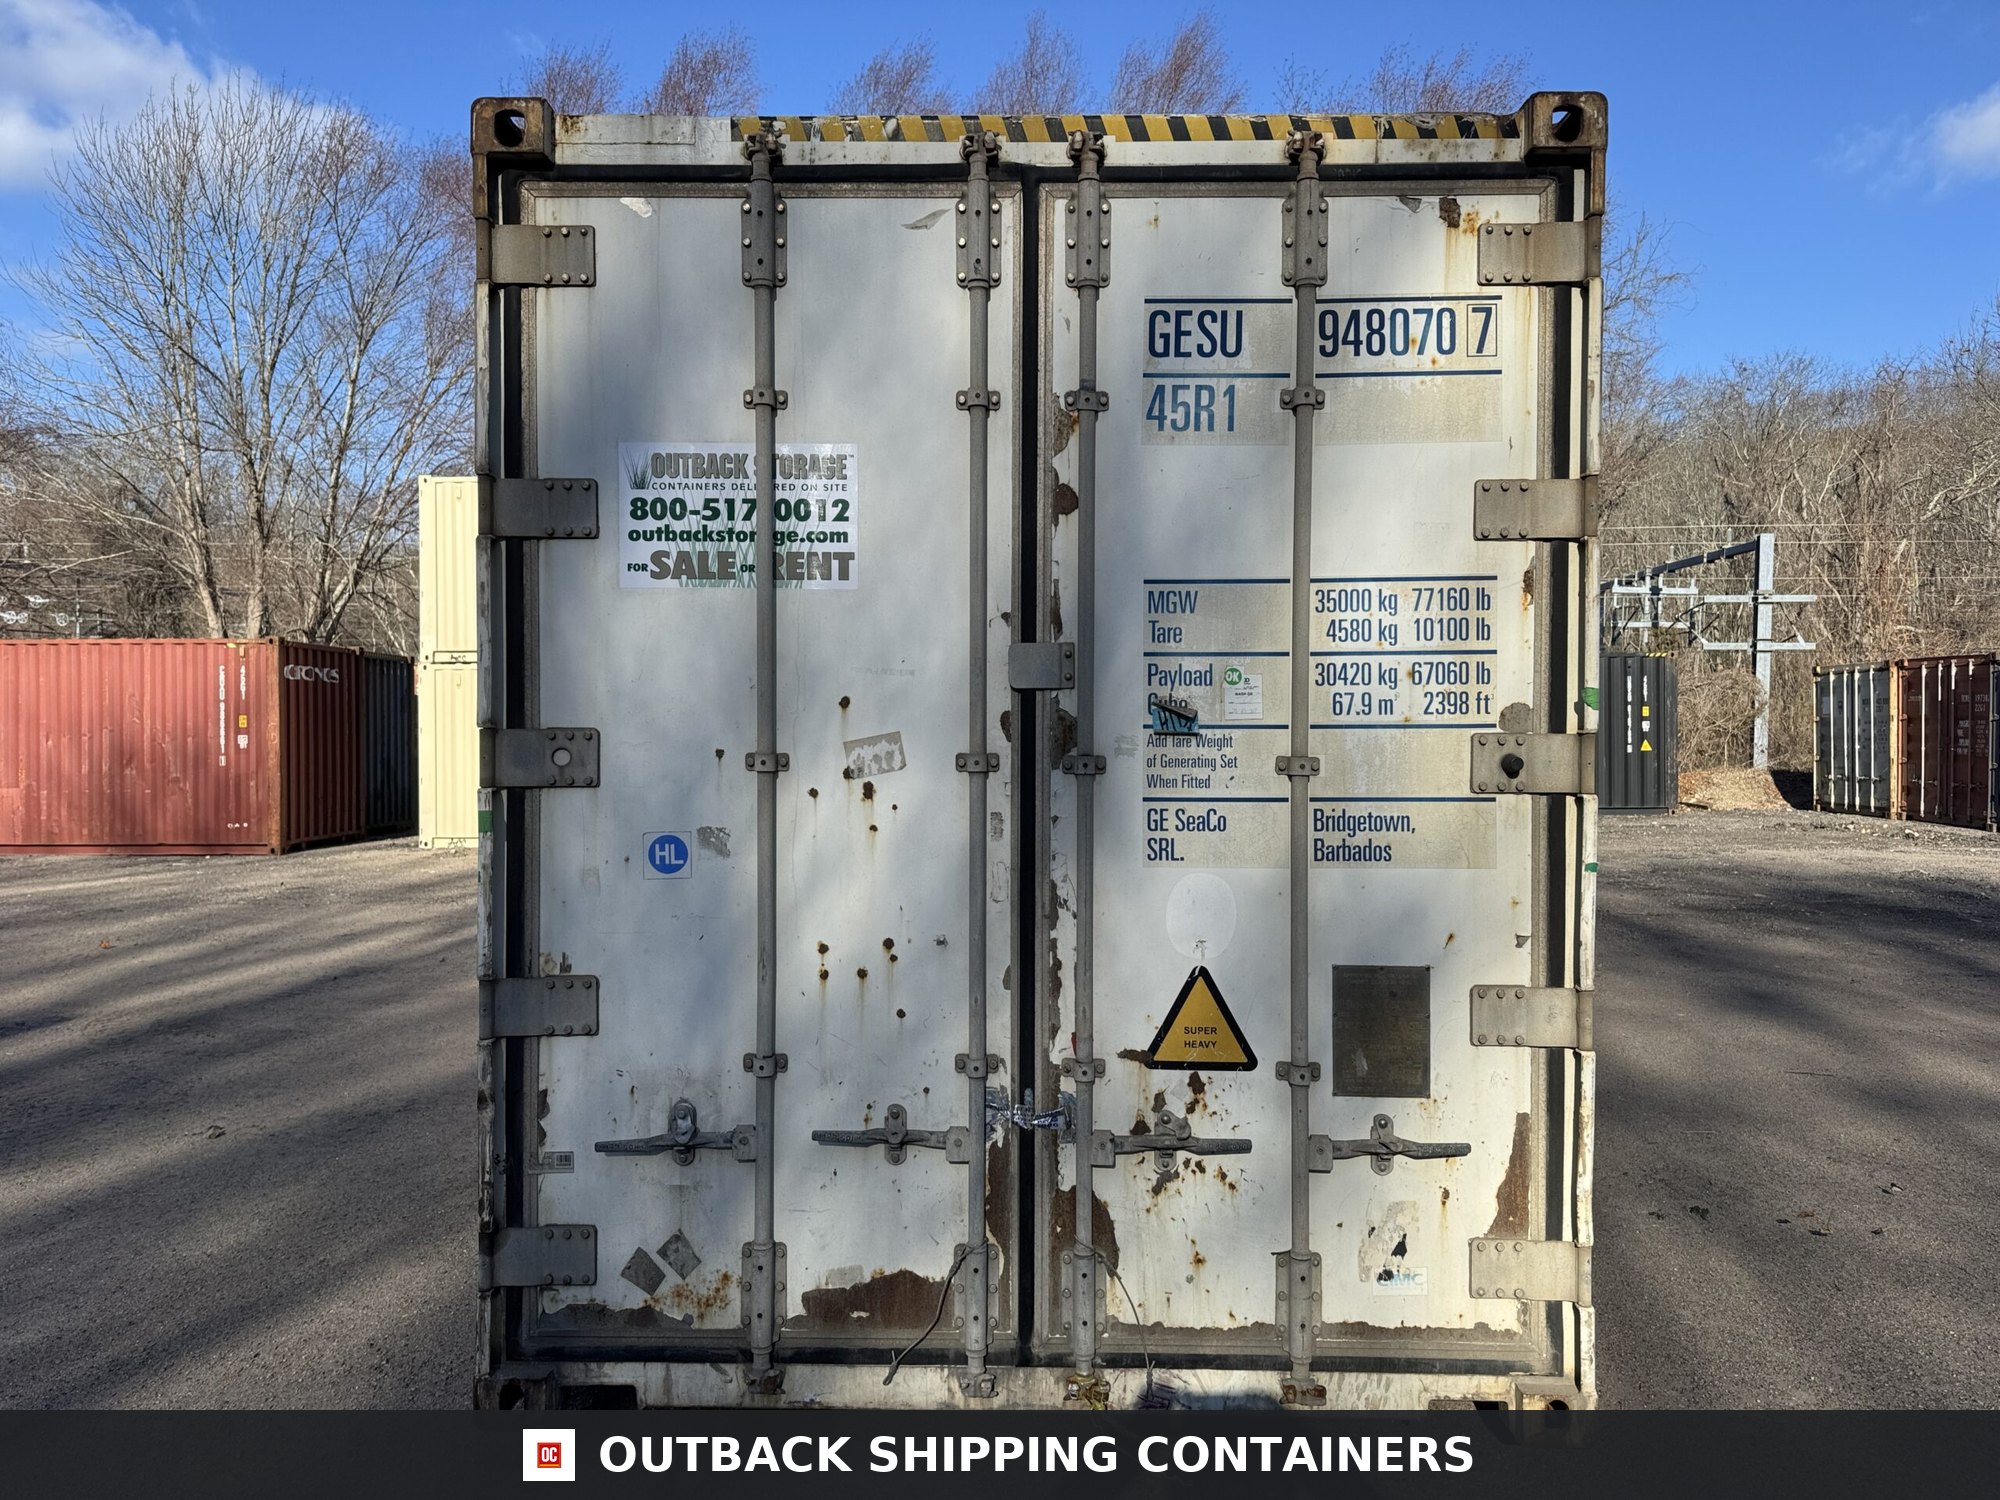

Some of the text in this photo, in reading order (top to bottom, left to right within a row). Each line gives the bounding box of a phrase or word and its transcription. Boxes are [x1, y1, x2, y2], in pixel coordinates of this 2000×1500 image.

[1149, 306, 1493, 358] GESU 948070 7
[1146, 384, 1236, 432] 45R1
[651, 452, 848, 480] OUTBACK TORAGE
[651, 482, 848, 492] CONTAINERS DELIRED ON SITE
[629, 497, 850, 522] 800-5170012
[627, 525, 849, 547] outbackstorge.com
[627, 550, 855, 581] FOR SALE OR RENT
[1148, 587, 1491, 616] MGW 35000 kg 77160 lb
[1148, 617, 1491, 646] Tare 4580 kg 10100 lb
[1148, 663, 1213, 691] Payload
[1314, 662, 1372, 687] 30420
[1378, 662, 1398, 690] kg
[1411, 661, 1470, 685] 67060
[1476, 661, 1491, 685] lb
[1226, 670, 1240, 683] OK
[1332, 691, 1372, 716] 67.9
[1423, 691, 1470, 716] 2398
[1146, 733, 1234, 752] Add Tare Weight
[1146, 754, 1238, 771] of Generating Set
[1146, 774, 1211, 789] When Fitted
[1147, 808, 1416, 838] GE SeaCo Bridgetown,
[655, 843, 684, 865] HL
[1147, 838, 1392, 862] SRL. Barbados
[1184, 1026, 1217, 1035] SUPER
[1184, 1040, 1217, 1049] HEAVY
